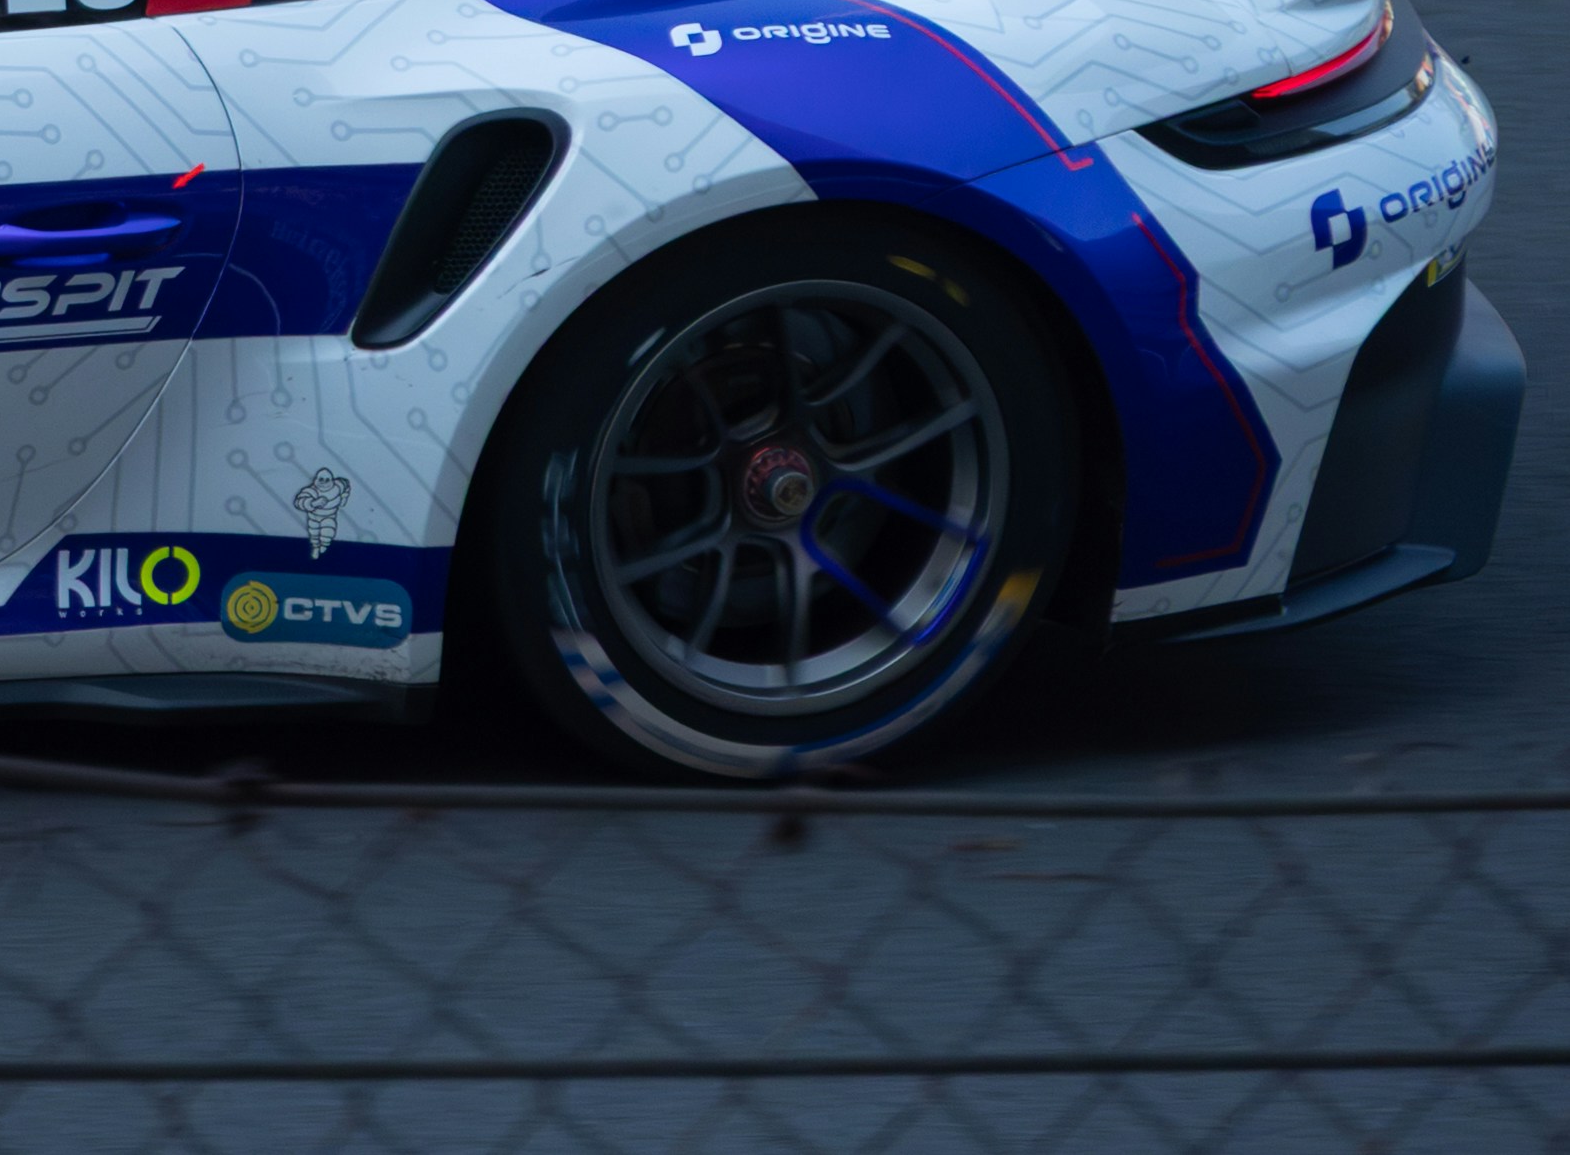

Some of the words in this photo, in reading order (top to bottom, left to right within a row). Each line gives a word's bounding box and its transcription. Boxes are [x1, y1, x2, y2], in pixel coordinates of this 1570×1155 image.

[58, 546, 201, 606] KILO
[58, 606, 144, 619] works
[283, 597, 403, 629] CTVS
